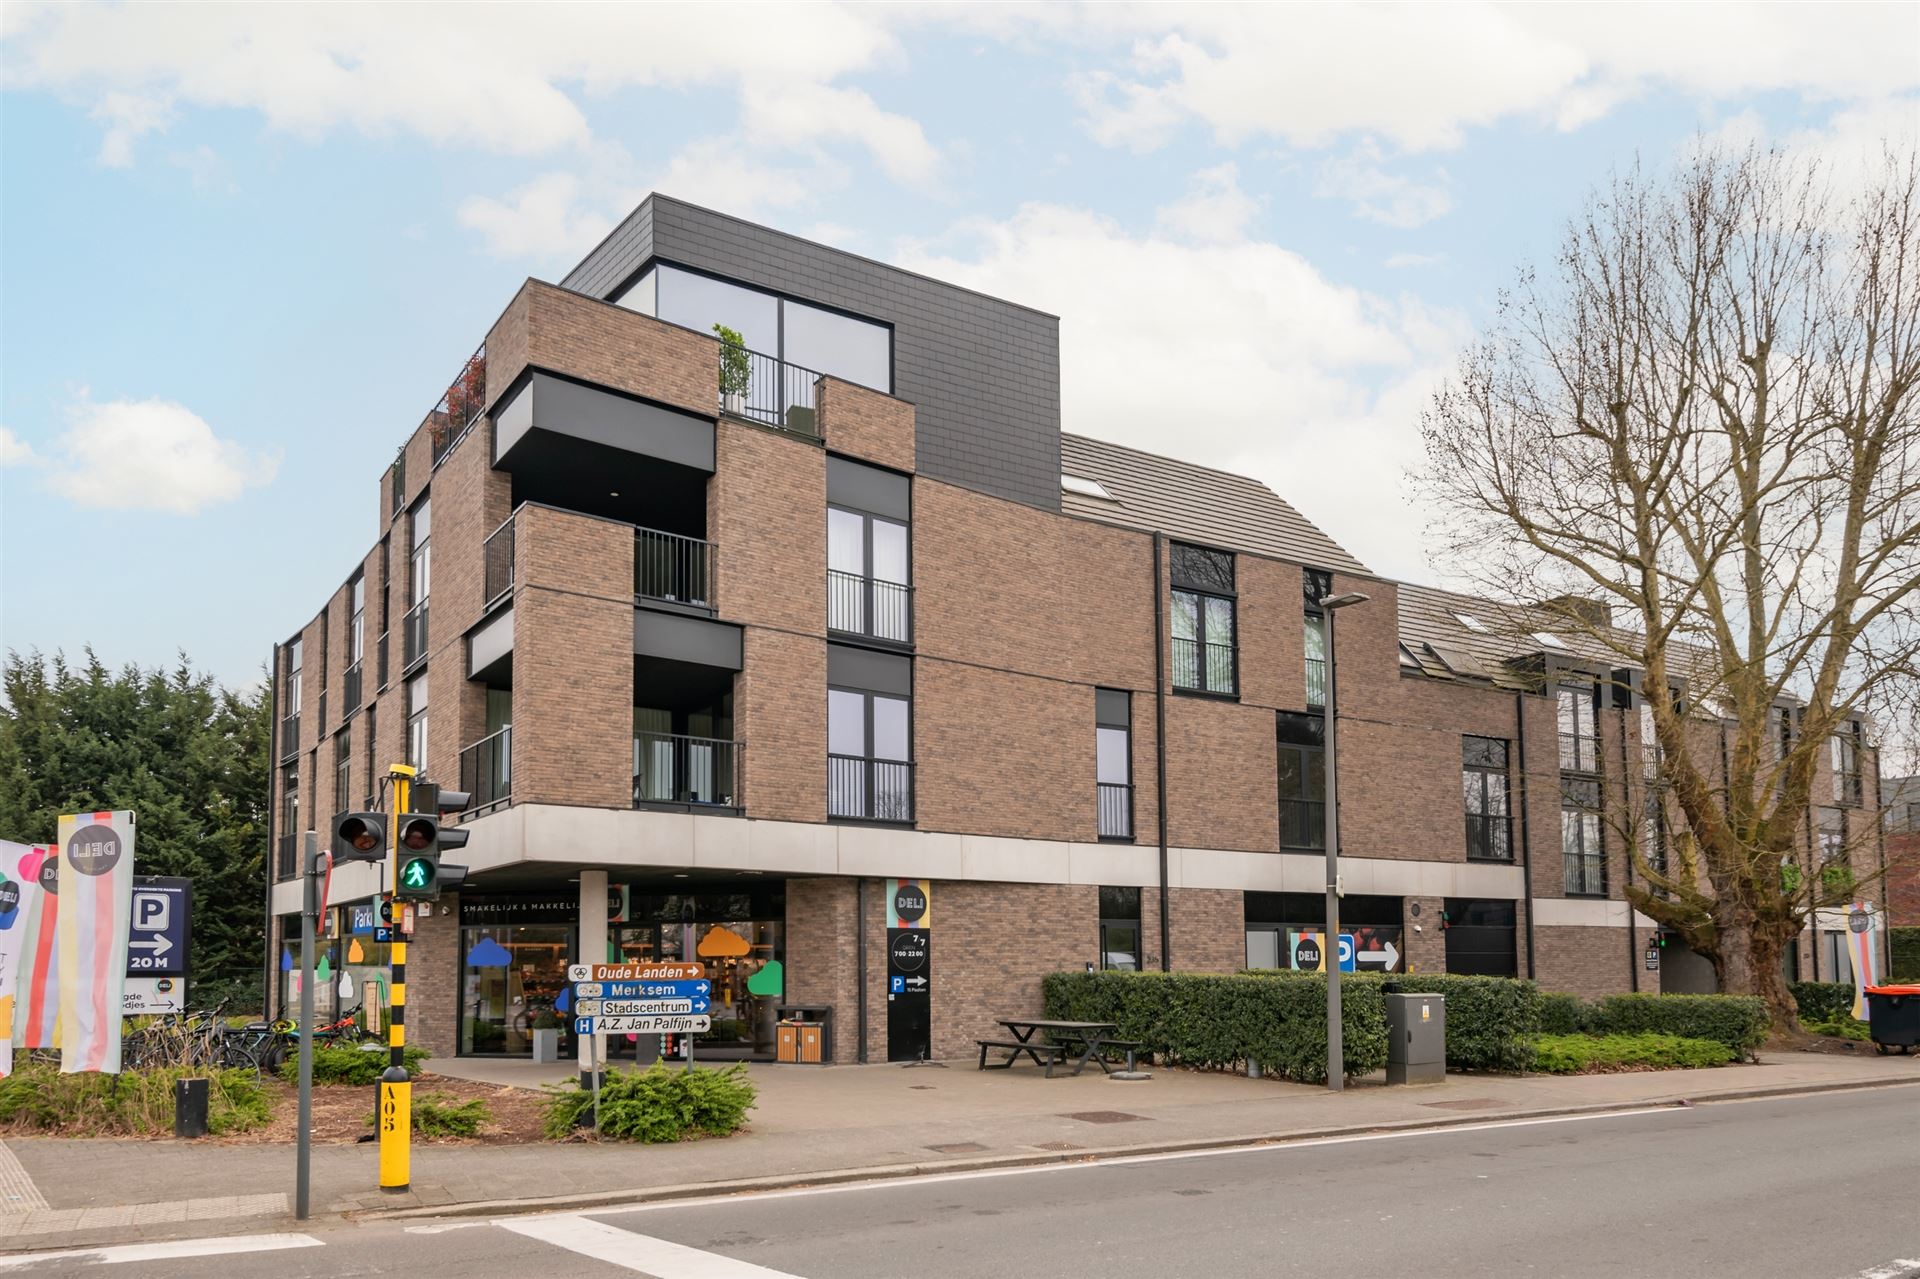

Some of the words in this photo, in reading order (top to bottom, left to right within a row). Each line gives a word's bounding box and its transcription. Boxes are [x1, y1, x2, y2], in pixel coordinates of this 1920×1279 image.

[463, 904, 518, 912] SMAKELIJK
[898, 897, 924, 909] DELI
[140, 899, 164, 925] P
[1298, 950, 1319, 961] DELI
[131, 957, 153, 968] 20
[154, 957, 168, 968] M
[597, 966, 632, 979] Oude
[635, 965, 683, 979] Landen
[611, 984, 676, 996] Merksem
[122, 1001, 146, 1009] djes
[605, 1001, 690, 1014] Stadscentrum
[580, 1020, 590, 1032] H
[597, 1019, 623, 1030] A.Z.
[627, 1018, 650, 1030] Jan
[653, 1017, 693, 1032] Palfijn
